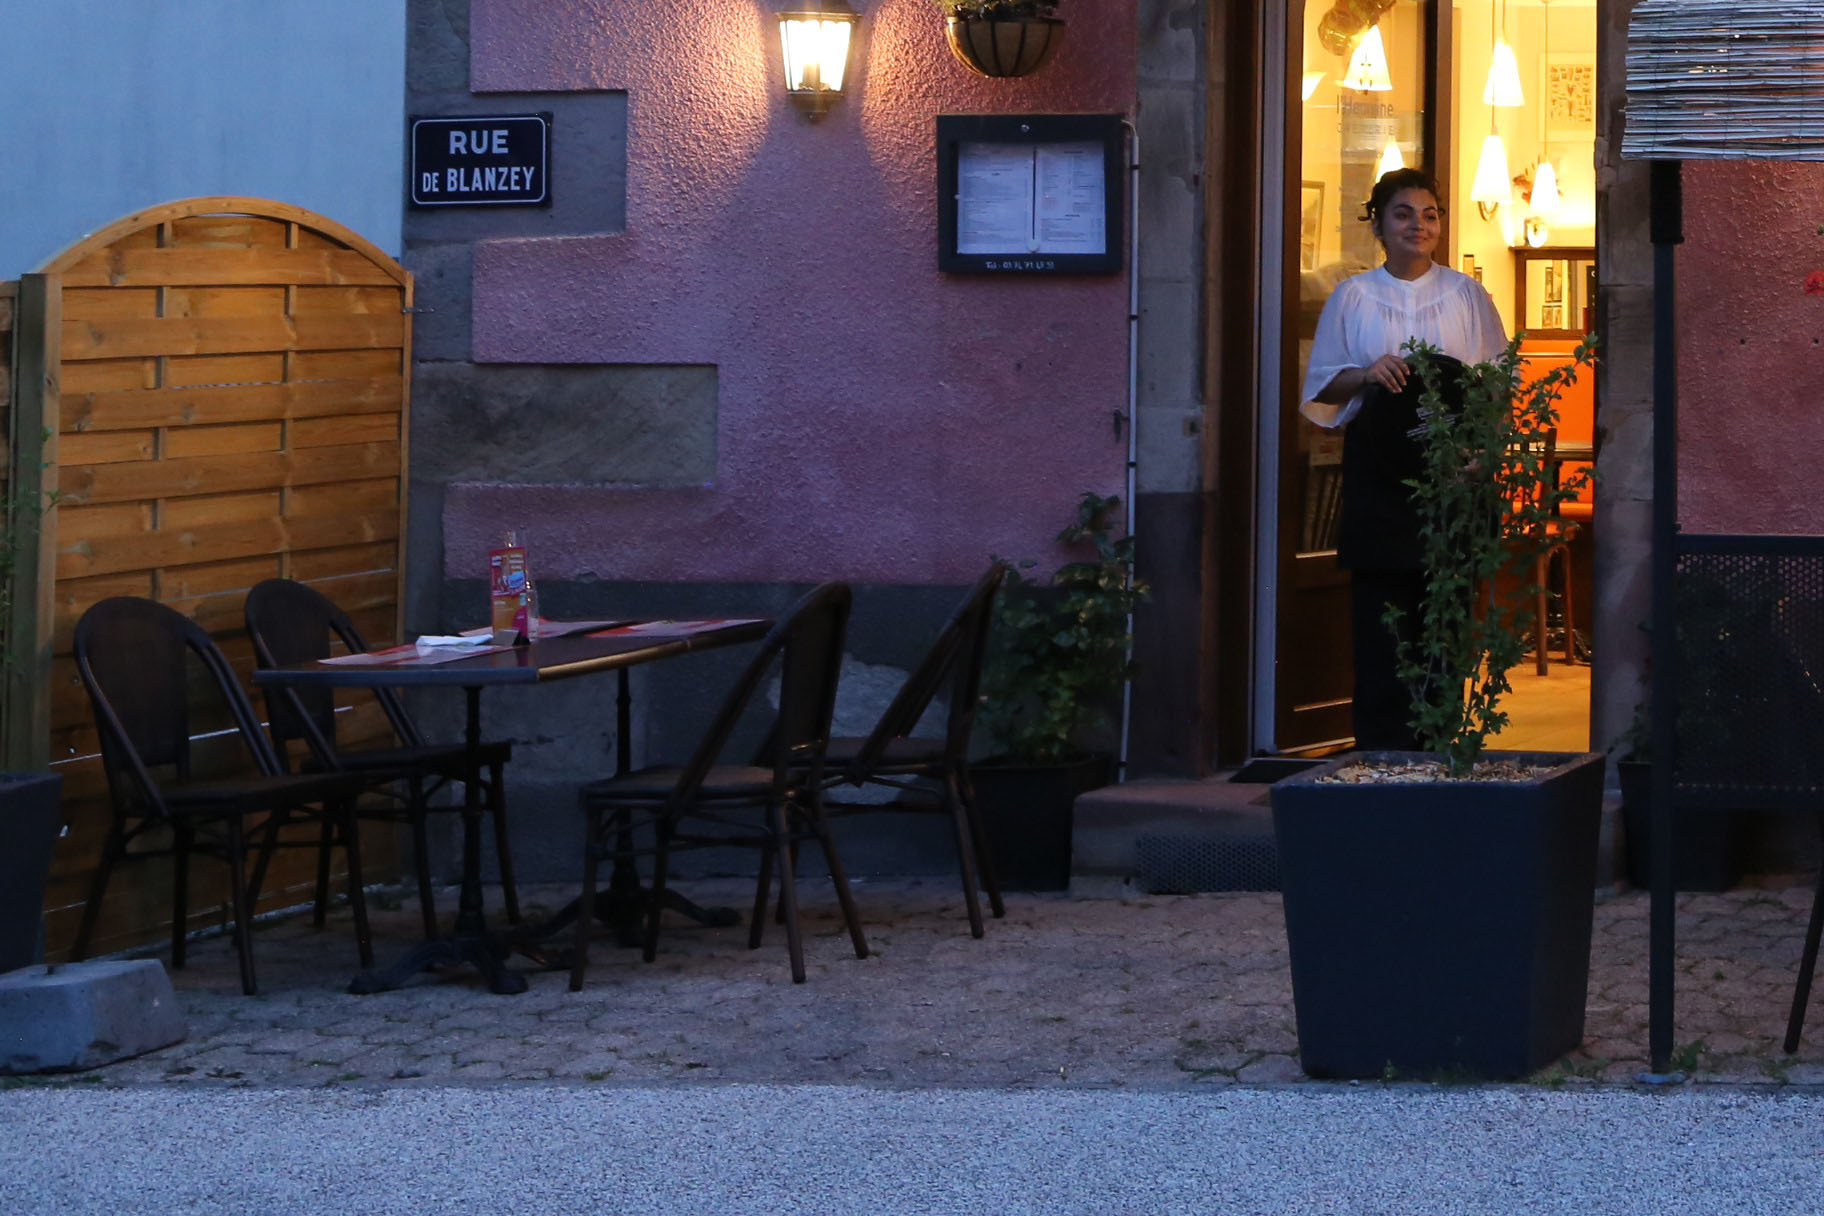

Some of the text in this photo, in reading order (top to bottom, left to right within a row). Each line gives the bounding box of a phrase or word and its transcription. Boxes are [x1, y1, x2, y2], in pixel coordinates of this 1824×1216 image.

[450, 130, 509, 154] RUE
[422, 166, 535, 192] DE BLANZEY
